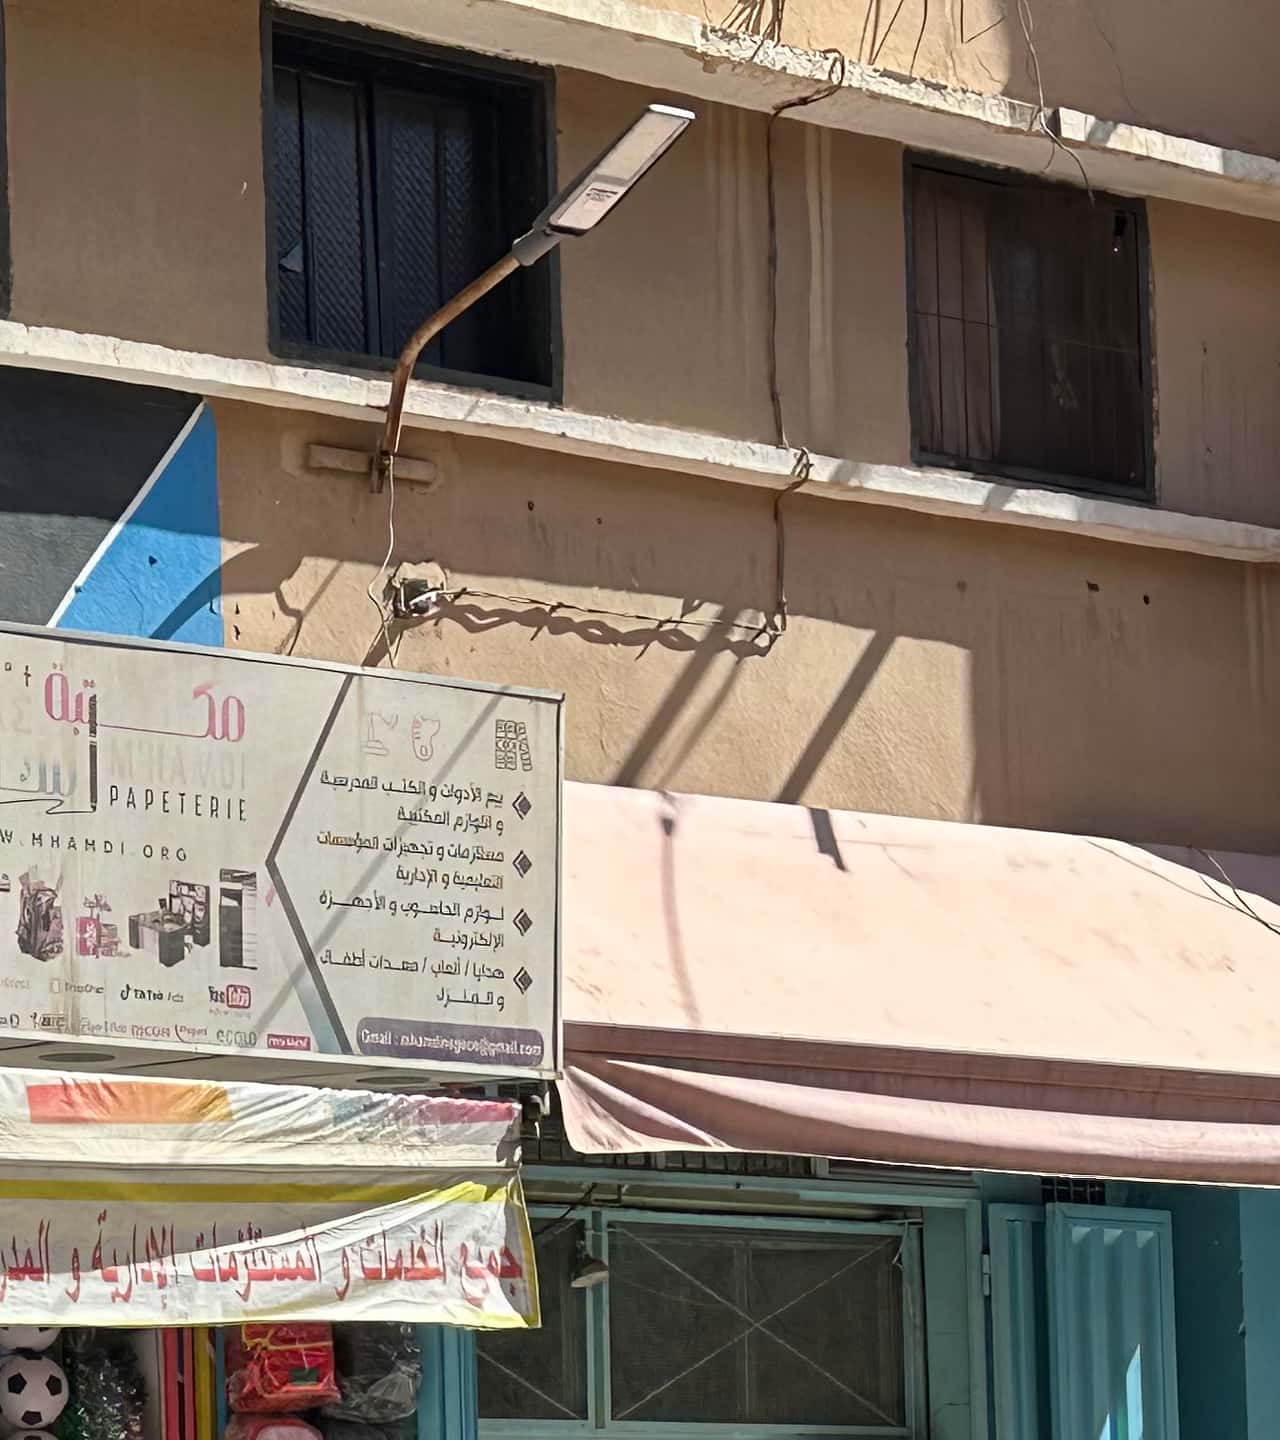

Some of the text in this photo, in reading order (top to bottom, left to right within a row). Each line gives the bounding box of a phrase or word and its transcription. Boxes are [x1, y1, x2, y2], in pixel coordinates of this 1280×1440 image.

[110, 785, 247, 822] PAPETERIE
[429, 785, 437, 802] و
[496, 820, 504, 836] و
[437, 845, 444, 861] و
[441, 873, 449, 889] و
[389, 901, 397, 917] و
[497, 996, 504, 1011] و
[191, 1220, 324, 1302] المستلزمات
[361, 1218, 447, 1282] الخدمات
[65, 1247, 81, 1303] و
[336, 1247, 351, 1300] و
[460, 1241, 523, 1310] جميع
